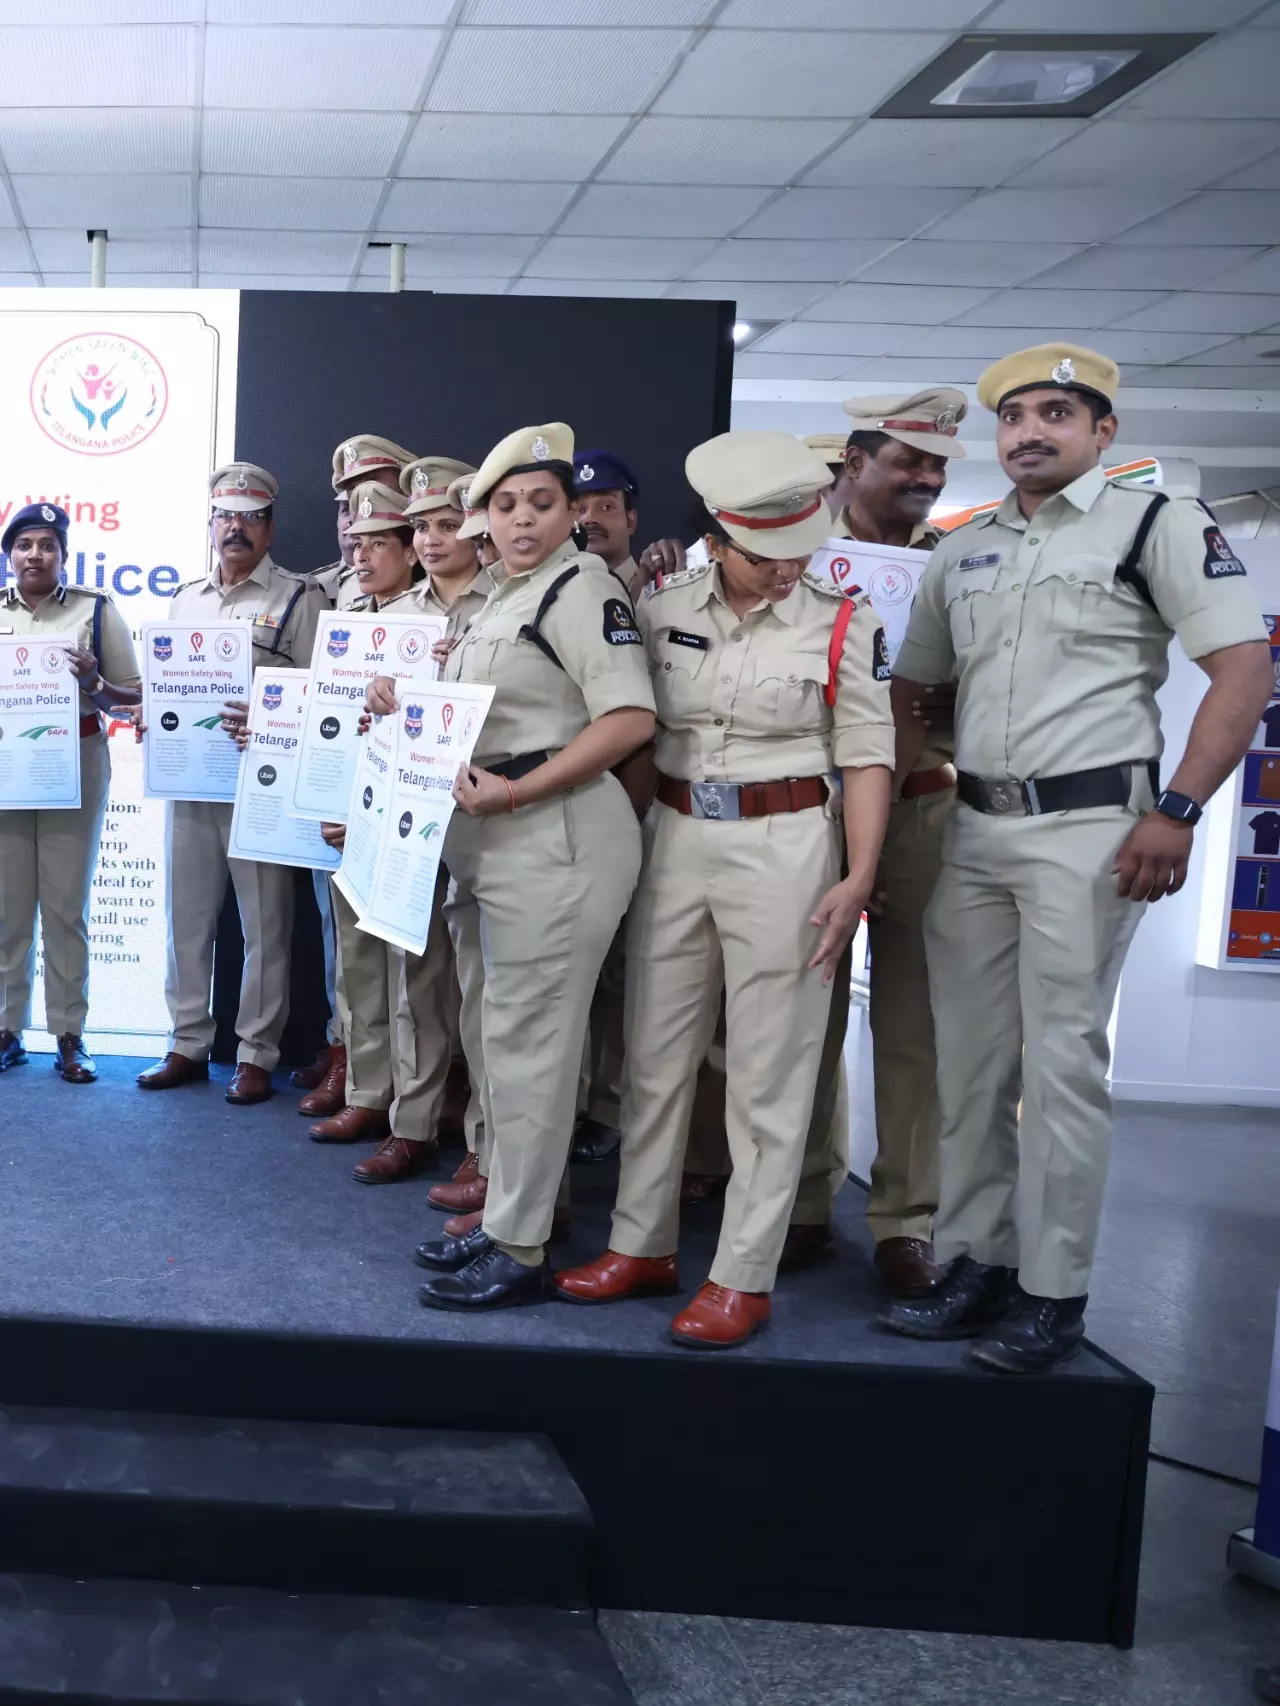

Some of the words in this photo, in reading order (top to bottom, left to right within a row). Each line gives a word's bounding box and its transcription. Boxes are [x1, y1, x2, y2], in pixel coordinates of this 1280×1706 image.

[838, 562, 844, 572] T
[188, 654, 206, 662] SAFE
[364, 652, 385, 662] SAFE
[13, 668, 32, 676] SAFE
[190, 670, 214, 678] Safety
[215, 670, 232, 678] Wing
[332, 668, 362, 678] Women
[16, 682, 39, 692] Safety
[40, 682, 59, 690] Wing
[150, 682, 207, 696] Telangana
[210, 684, 244, 694] Police
[316, 682, 364, 700] Telanga
[36, 694, 70, 705] Police
[267, 720, 296, 729] Women
[322, 724, 338, 732] Uber
[254, 732, 298, 750] Telanga
[436, 734, 452, 746] SAFE
[366, 747, 388, 773] Telanga
[260, 772, 274, 780] Uber
[401, 820, 410, 830] Uber
[100, 839, 128, 854] trip
[122, 858, 156, 870] with
[92, 876, 125, 888] deal
[130, 876, 154, 889] for
[97, 896, 133, 908] want
[140, 896, 154, 908] to
[90, 912, 118, 925] still
[124, 914, 148, 926] use
